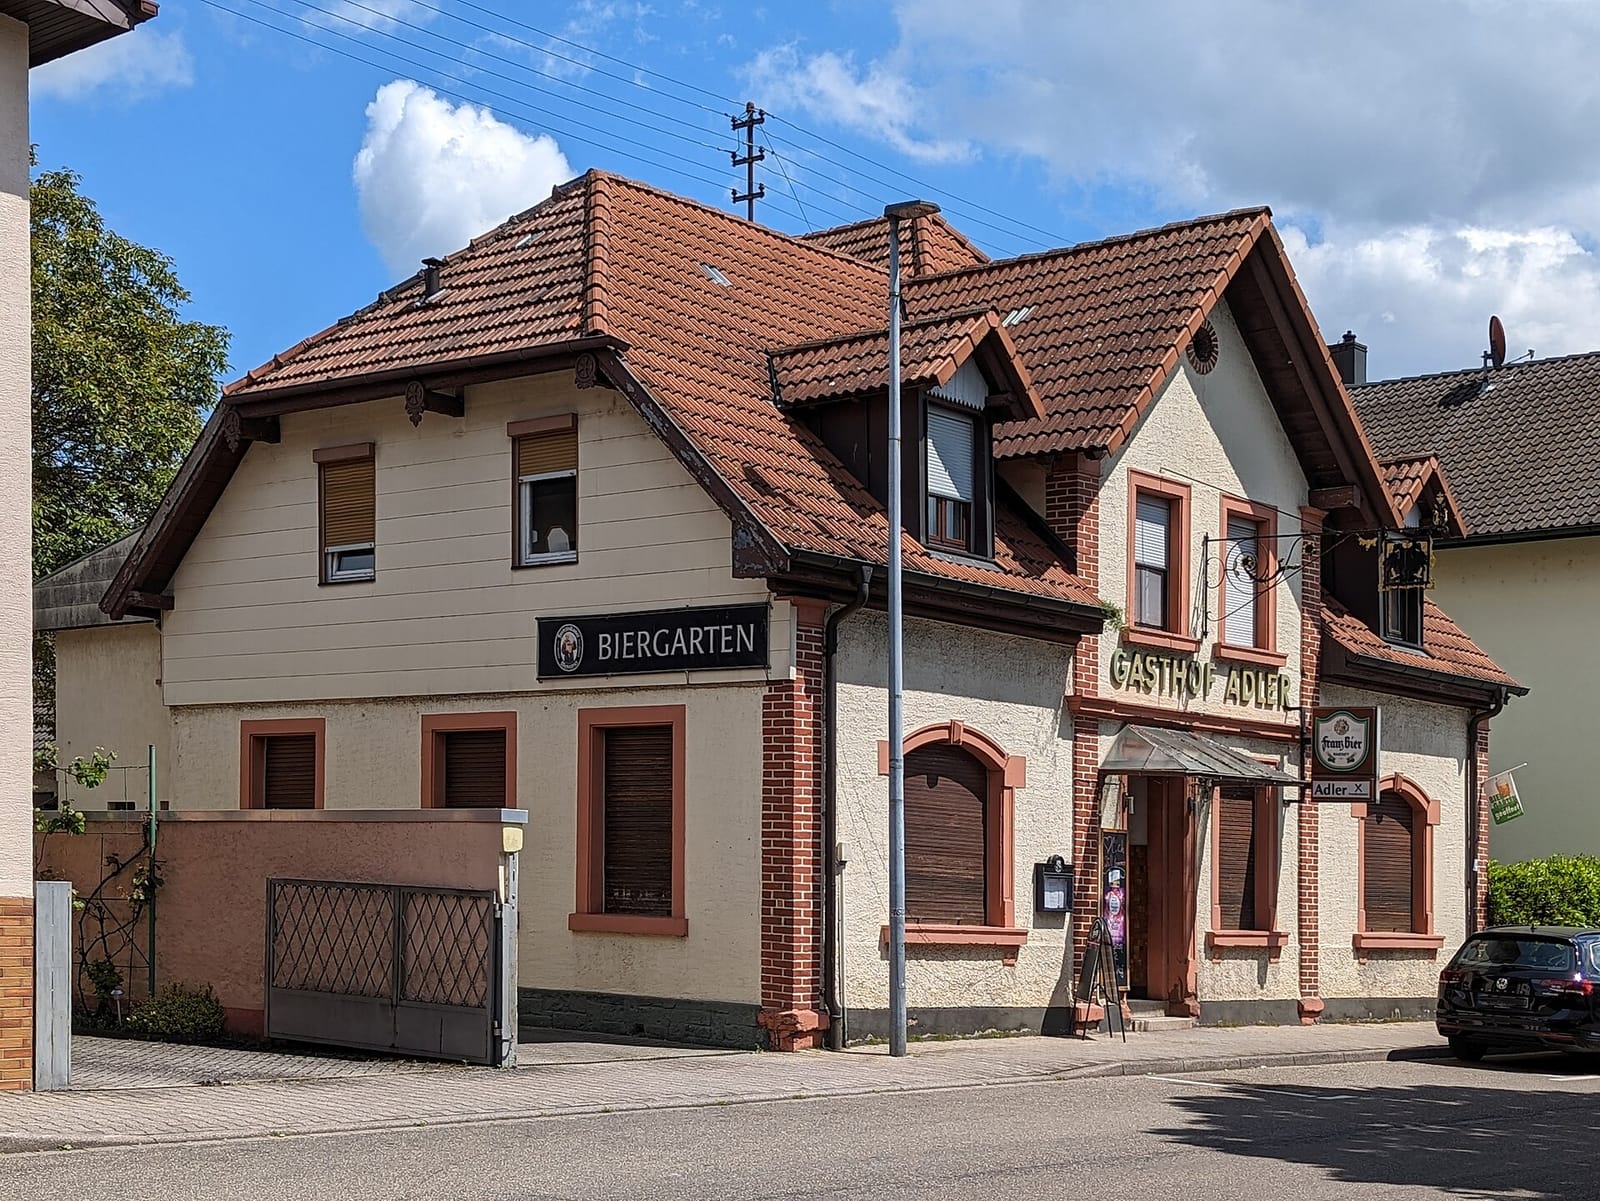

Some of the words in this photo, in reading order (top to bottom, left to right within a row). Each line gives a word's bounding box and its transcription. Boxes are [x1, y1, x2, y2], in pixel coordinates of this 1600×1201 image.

[598, 623, 755, 660] BIERGARTEN
[1110, 647, 1217, 700] GASTHOF
[1224, 668, 1292, 707] ADLER
[1314, 783, 1347, 796] Adler
